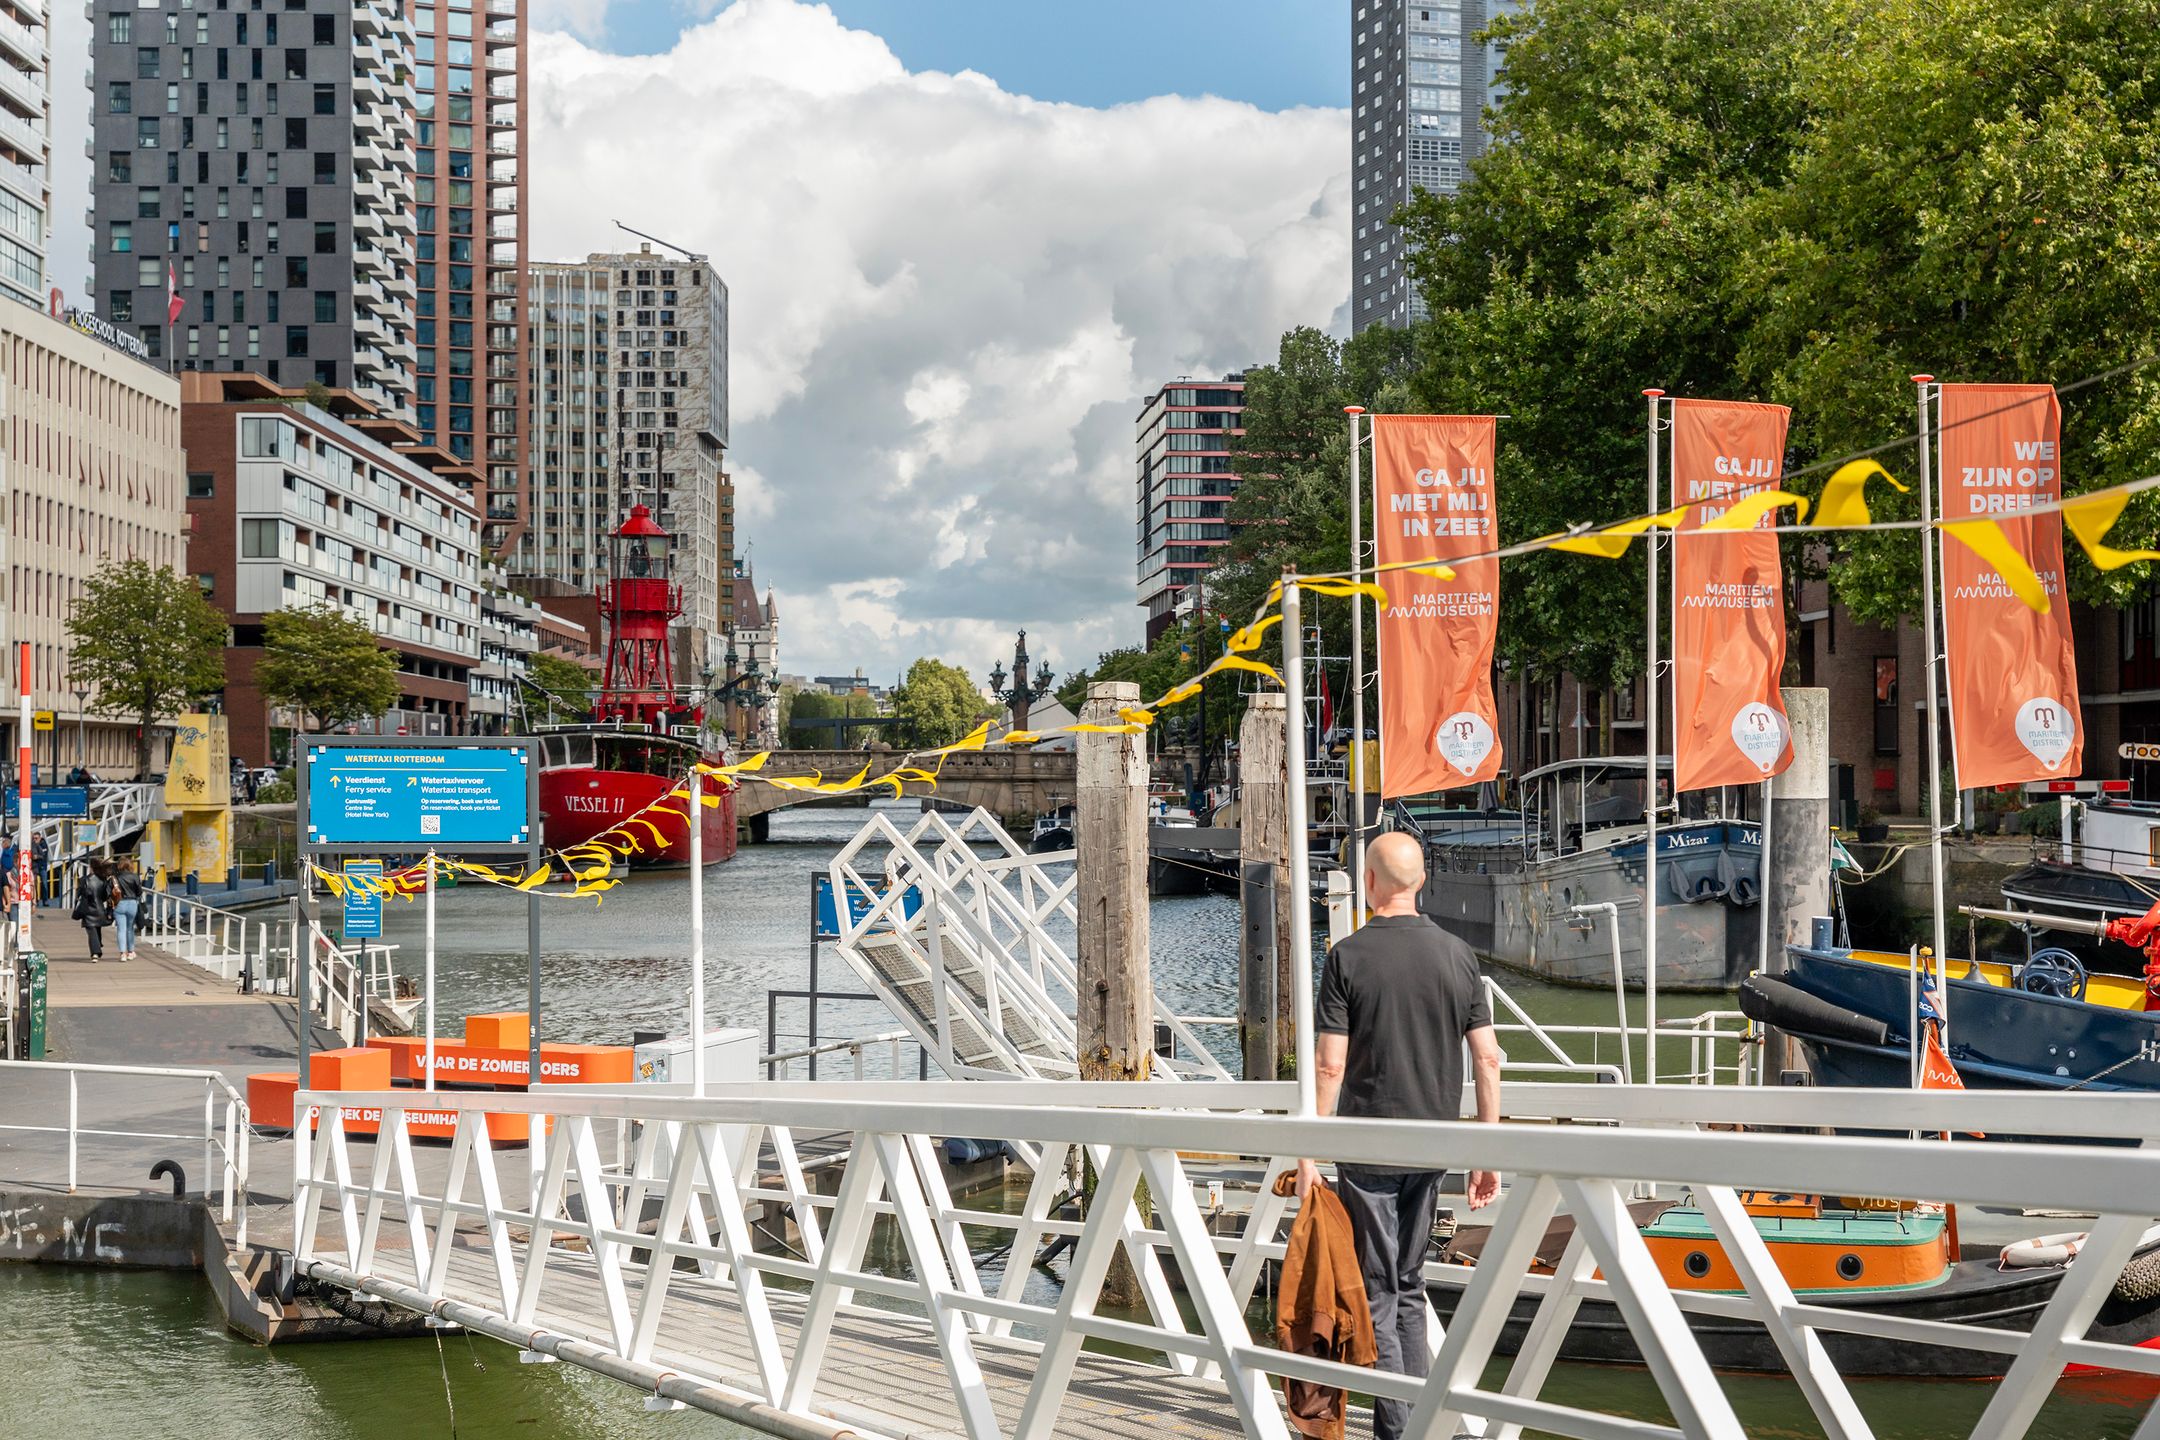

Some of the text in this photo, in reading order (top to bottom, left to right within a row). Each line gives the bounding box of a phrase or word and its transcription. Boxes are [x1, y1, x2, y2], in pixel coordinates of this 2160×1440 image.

[76, 307, 148, 359] HOGESCHOOL ROTTERDAM
[2014, 441, 2054, 460] WE
[1714, 455, 1773, 478] GA JIJ
[1415, 467, 1485, 487] GA JIJ
[1962, 467, 2054, 487] ZIJN OP
[1689, 479, 1735, 500] MET
[1390, 492, 1488, 513] MET MIJ
[1403, 517, 1490, 537] IN ZEE?
[1705, 583, 1773, 596] MARITIEM
[1413, 592, 1492, 605] MARITIEM
[1747, 741, 1779, 750] DISTRICT
[2032, 738, 2064, 747] DISTRICT
[345, 755, 445, 763] WATERTAXI ROTTERDAM
[345, 776, 385, 784] Veerdienst
[421, 777, 484, 785] Watertaxivervoer
[345, 786, 392, 795] Ferry service
[421, 786, 491, 795] Watertaxi transport
[564, 795, 609, 813] VESSEL
[1667, 833, 1709, 849] Mizar
[415, 1054, 580, 1077] VAR DE ZOMEROERS
[364, 1110, 381, 1122] DE
